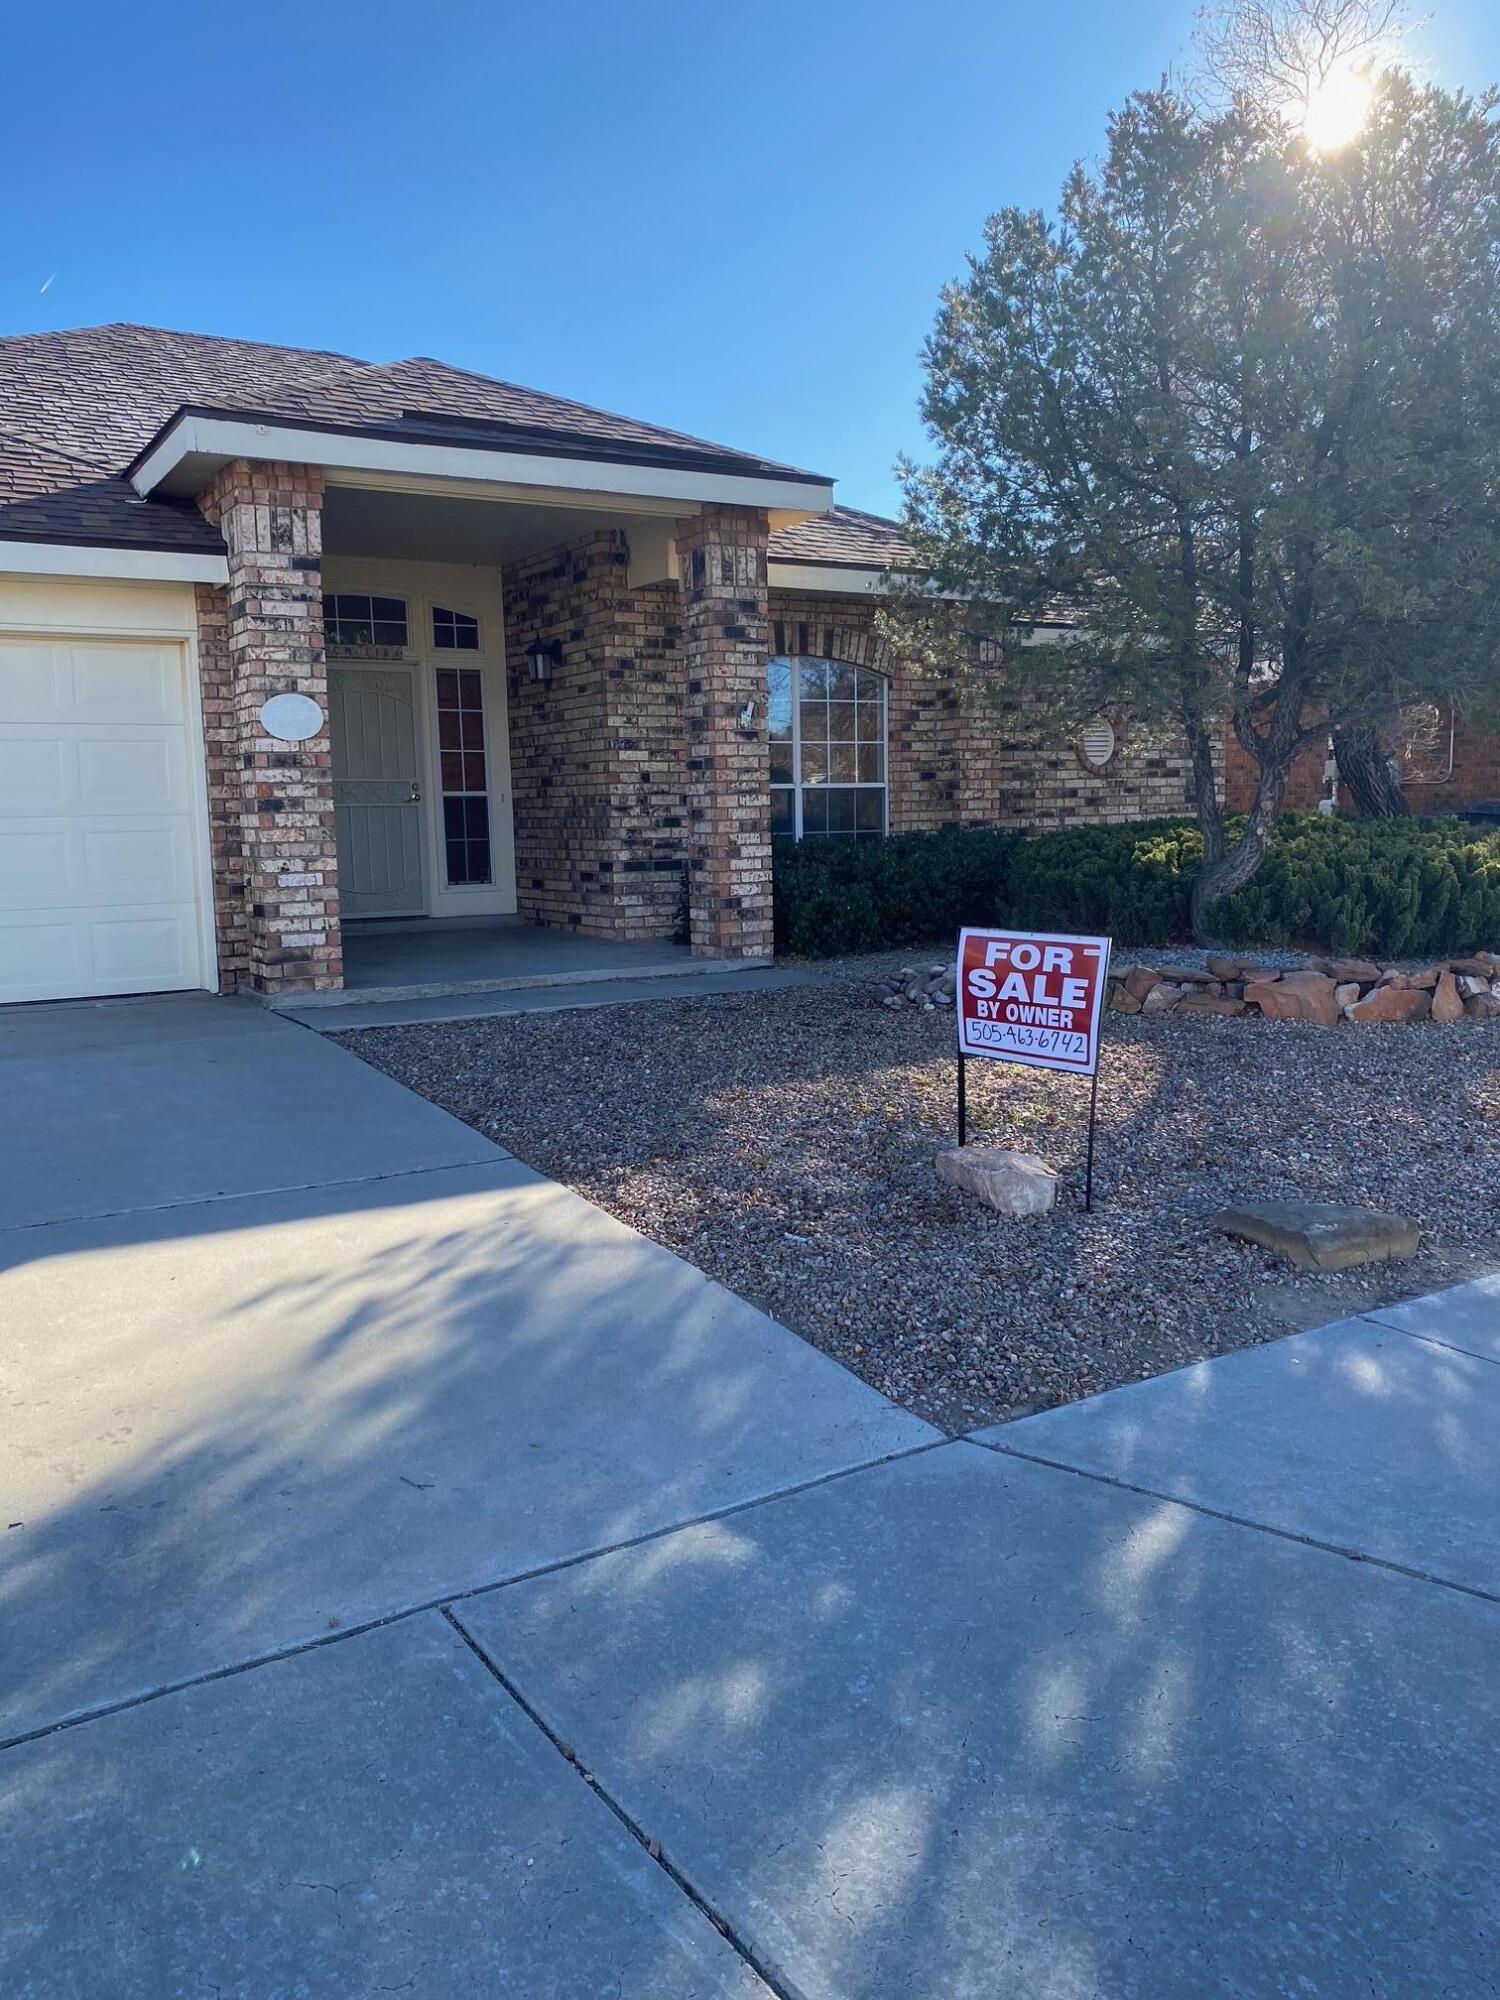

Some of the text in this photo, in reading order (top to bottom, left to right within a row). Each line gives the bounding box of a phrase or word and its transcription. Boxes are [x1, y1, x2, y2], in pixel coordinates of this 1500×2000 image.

[985, 941, 1073, 974] FOR
[968, 968, 1089, 1009] SALE
[977, 1000, 1073, 1029] BY OWNER
